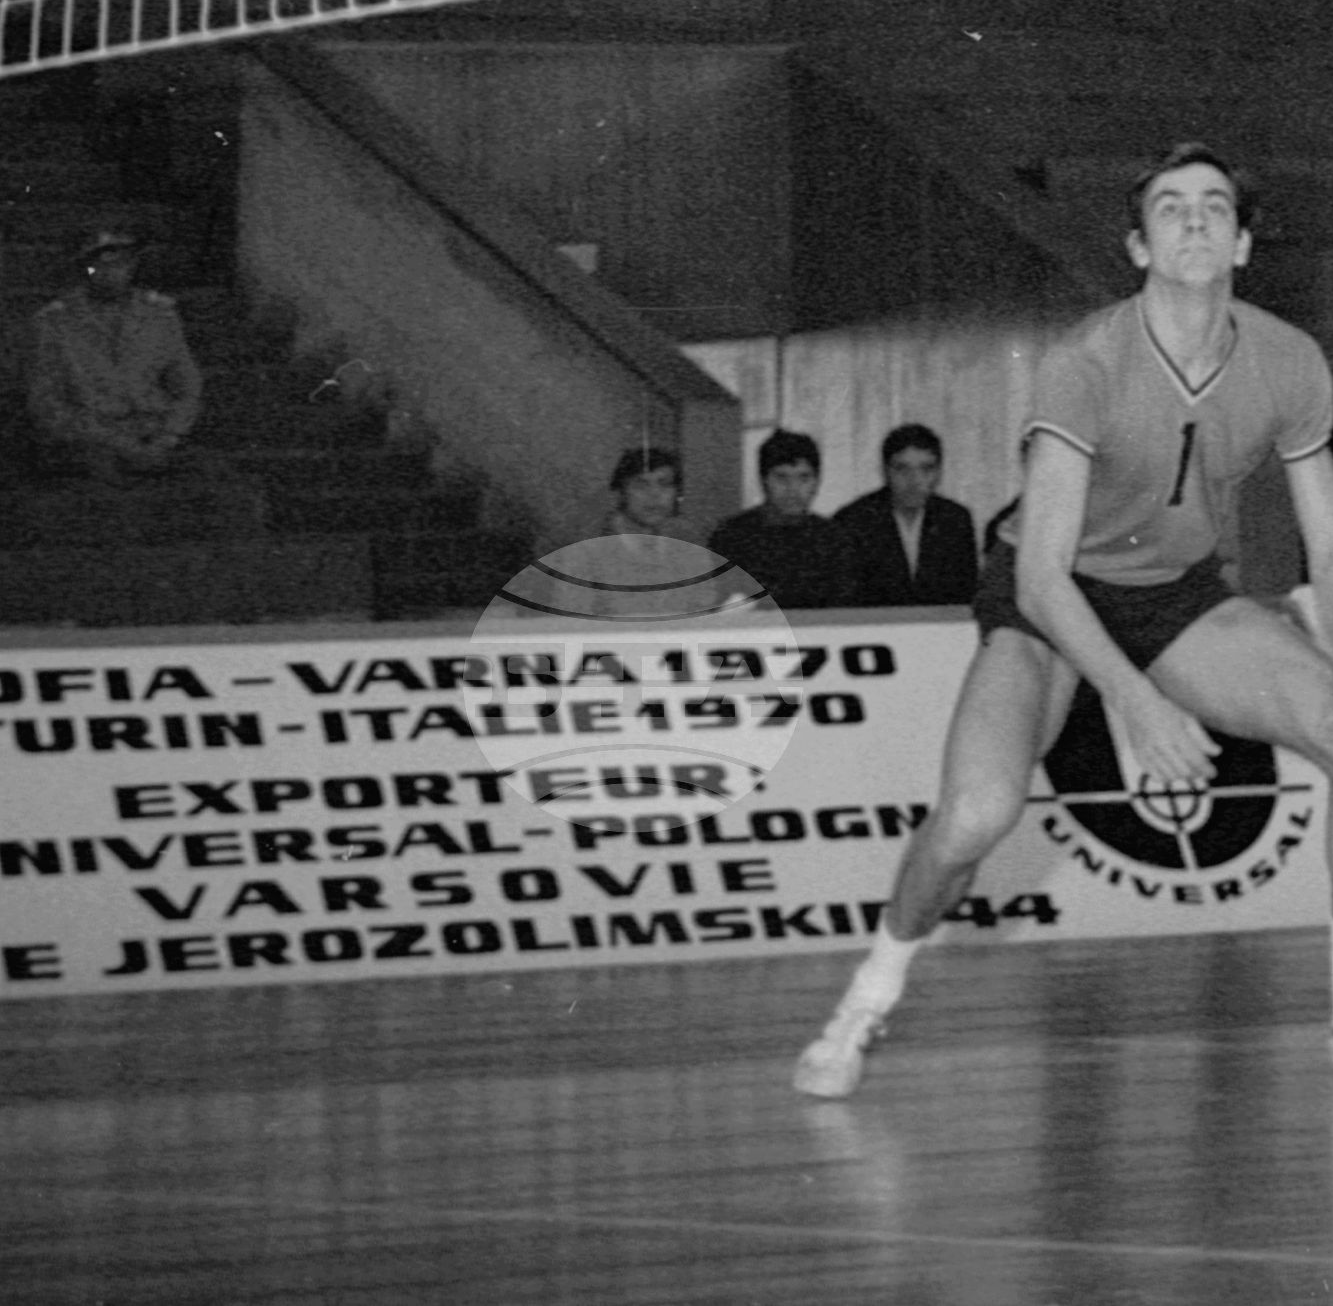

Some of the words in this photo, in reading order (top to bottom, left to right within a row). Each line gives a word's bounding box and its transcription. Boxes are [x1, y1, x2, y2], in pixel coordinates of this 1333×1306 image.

[1167, 422, 1197, 507] 1
[134, 857, 777, 921] VARSOVIE
[1042, 806, 1313, 903] UNIVERSAL
